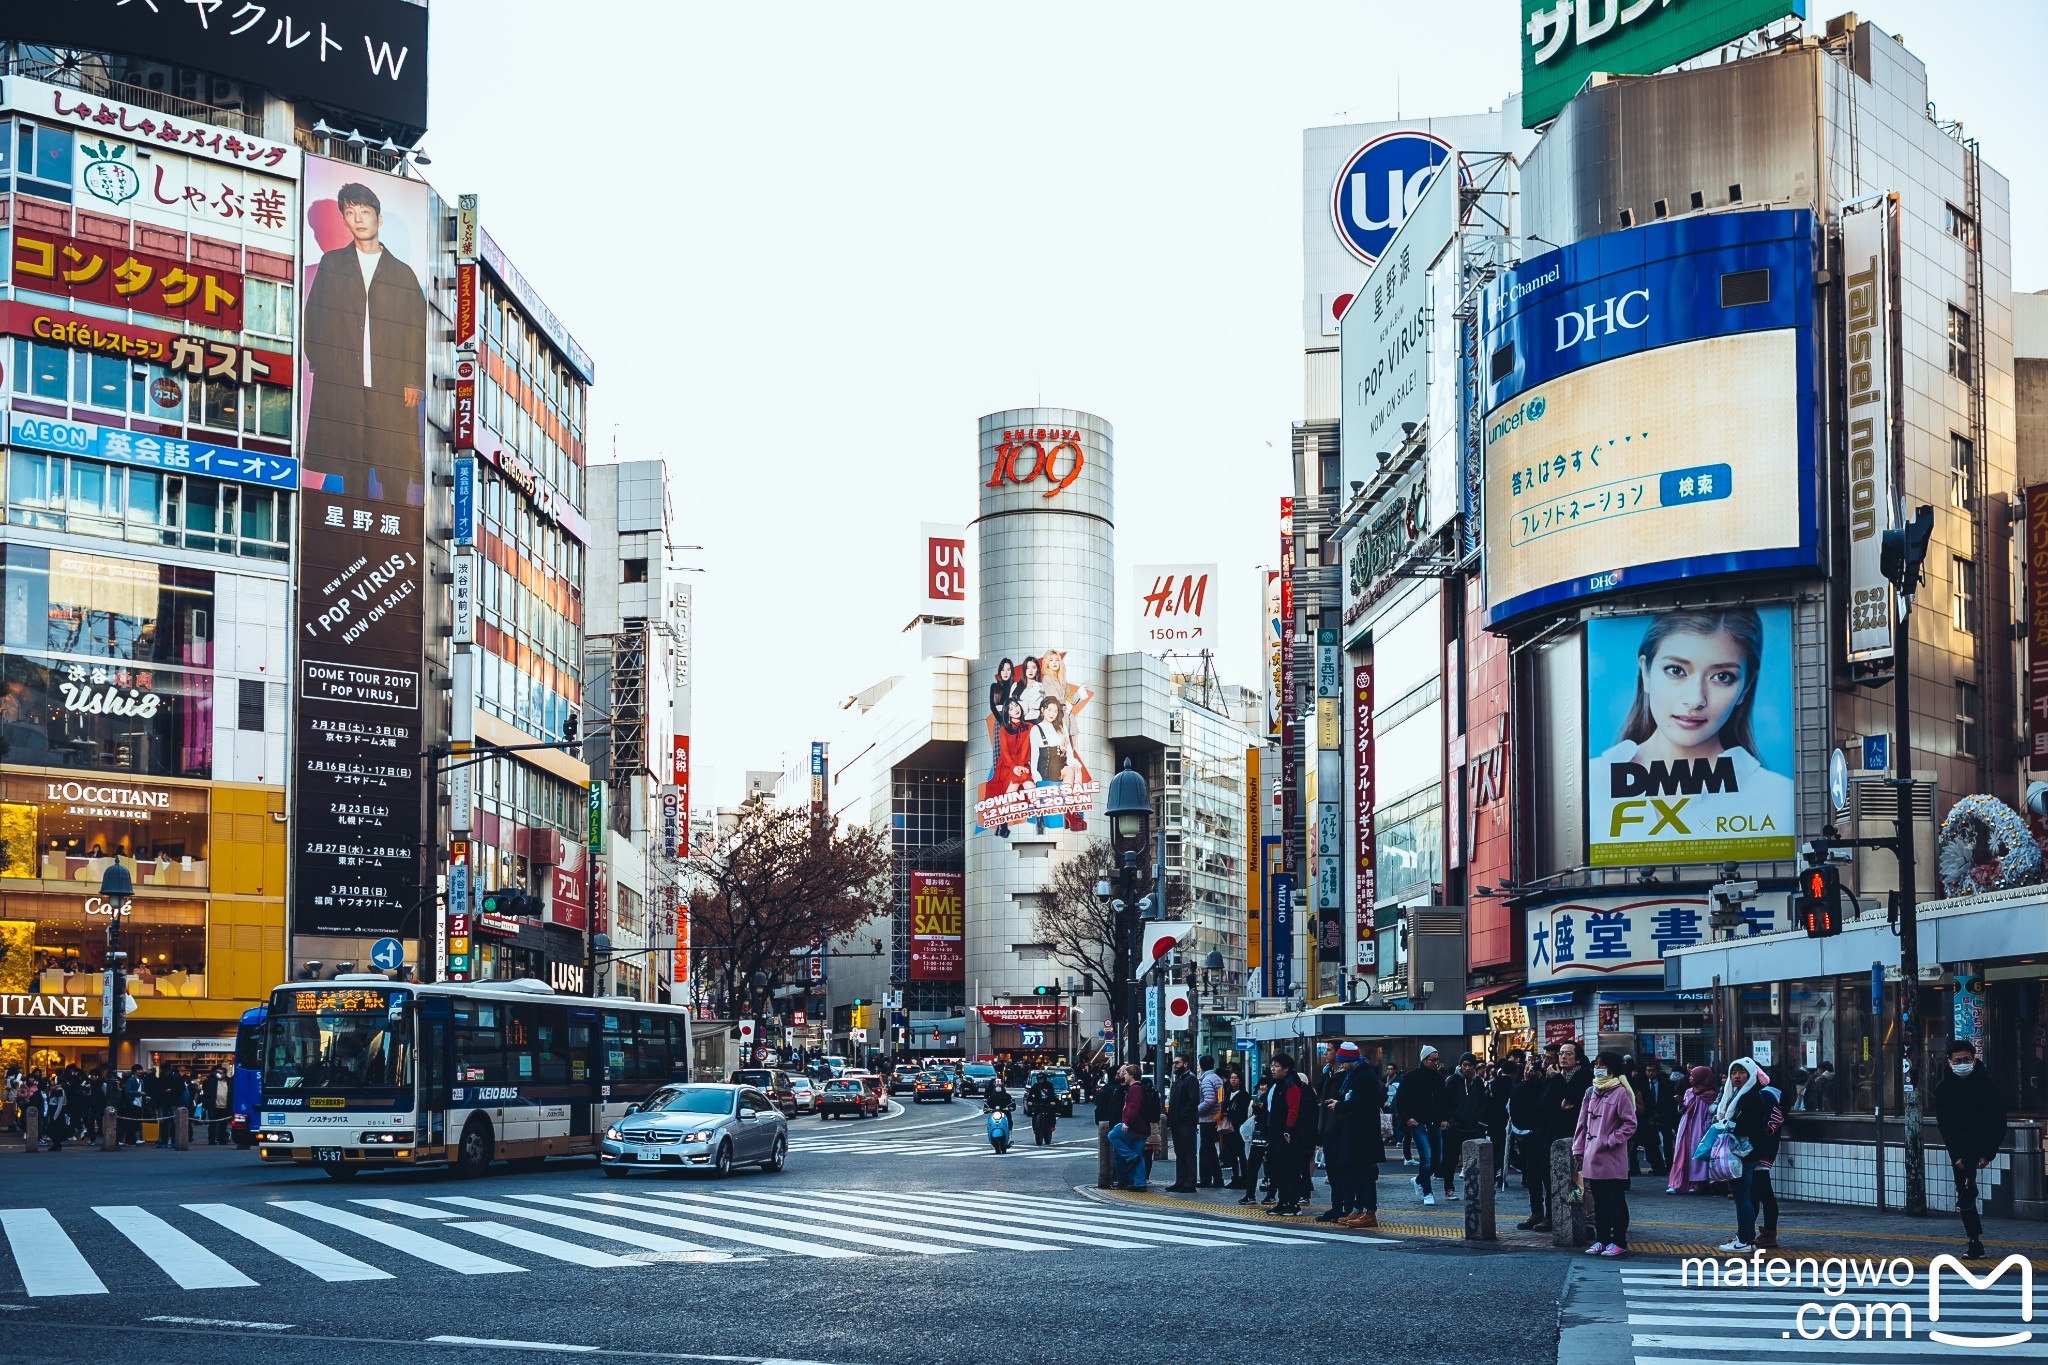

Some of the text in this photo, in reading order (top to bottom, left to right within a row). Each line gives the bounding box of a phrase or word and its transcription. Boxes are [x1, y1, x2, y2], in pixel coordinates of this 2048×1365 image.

[364, 35, 408, 81] W
[53, 90, 287, 168] しゃぶしゃぶバイキング
[154, 163, 287, 229] しゃぶ葉
[462, 212, 474, 255] しゃぶ葉
[15, 236, 236, 314] コンタクト
[1374, 243, 1411, 324] 星野源
[1487, 264, 1560, 318] DHC Channel
[461, 299, 471, 338] コンタクト
[1380, 304, 1405, 344] NEW ALBUM
[1555, 288, 1650, 352] DHC
[464, 341, 475, 350] 8F
[1388, 306, 1425, 375] VIRUS
[171, 336, 270, 384] ガスト
[154, 389, 179, 401] ガスト
[1370, 410, 1385, 438] NOW
[1386, 394, 1397, 418] ON
[1397, 369, 1417, 406] SALE!
[1848, 255, 1881, 542] Taisei neon
[459, 398, 472, 439] ガスト
[1003, 429, 1082, 442] SHIBUYA
[1488, 404, 1525, 446] unicef
[22, 420, 292, 482] AEON 英会話イーオン
[985, 439, 1085, 499] 109
[1511, 444, 1603, 497] 答えは今すぐ
[1678, 474, 1713, 498] 検索
[459, 467, 469, 536] 英会話イーオン
[1521, 484, 1644, 537] フレンドネーション
[324, 505, 401, 536] 星野源
[322, 556, 368, 596] NEW ALBUM
[1590, 573, 1619, 590] DHC
[341, 579, 416, 645] NOW ON SALE!
[457, 563, 469, 636] 渋谷駅前ビル
[1143, 573, 1208, 619] H&M
[675, 592, 689, 688] BIC CAMERA
[1853, 617, 1888, 633] 2468
[68, 664, 153, 691] 渋谷焼肉
[308, 667, 412, 688] DOME TOUR 2019
[1321, 647, 1335, 686] 渋谷西村
[60, 682, 161, 719] Ushi8
[325, 732, 397, 748] 京セラドーム大阪
[676, 748, 687, 773] 免税
[1610, 756, 1739, 798] DMM
[48, 782, 169, 809] L'OCCITANE
[334, 774, 387, 787] ナゴヤドーム
[1357, 704, 1371, 855] ウィンターフルーツギフト
[69, 806, 149, 820] EN PROVENCE
[338, 816, 382, 826] 札幌ドーム
[663, 794, 678, 818] OS
[982, 794, 1092, 820] 1.2 SUN
[984, 804, 1093, 828] 2019 HAPPY NEW YEAR
[1609, 798, 1776, 837] FX ROLA
[1250, 814, 1258, 872] Matsumoto
[1320, 818, 1329, 844] パーラー
[338, 856, 382, 867] 東京ドーム
[456, 868, 466, 911] 渋谷駅前
[559, 873, 580, 901] アコム
[922, 886, 954, 895] 全館一斉
[1321, 870, 1329, 896] フルーツ
[1366, 868, 1375, 928] 無料配送地域
[85, 897, 132, 918] Caé
[314, 896, 403, 909] 福岡 ヤフオク!ドーム
[565, 908, 573, 922] 3F
[915, 896, 961, 915] TIME
[1278, 884, 1287, 923] MIZUHO
[915, 915, 961, 935] SALE
[551, 961, 584, 993] LUSH
[1276, 953, 1285, 995] みずほ銀行
[1974, 981, 1982, 992] 6
[317, 998, 385, 1009] 渋谷駅
[794, 1017, 805, 1025] QLO
[1148, 987, 1157, 1034] 文化村通り
[55, 1025, 96, 1033] L'OCCITANE
[267, 1098, 303, 1106] KEIO BUS
[478, 1086, 518, 1100] KEIO BUS
[307, 1115, 349, 1123] ノンステップバス
